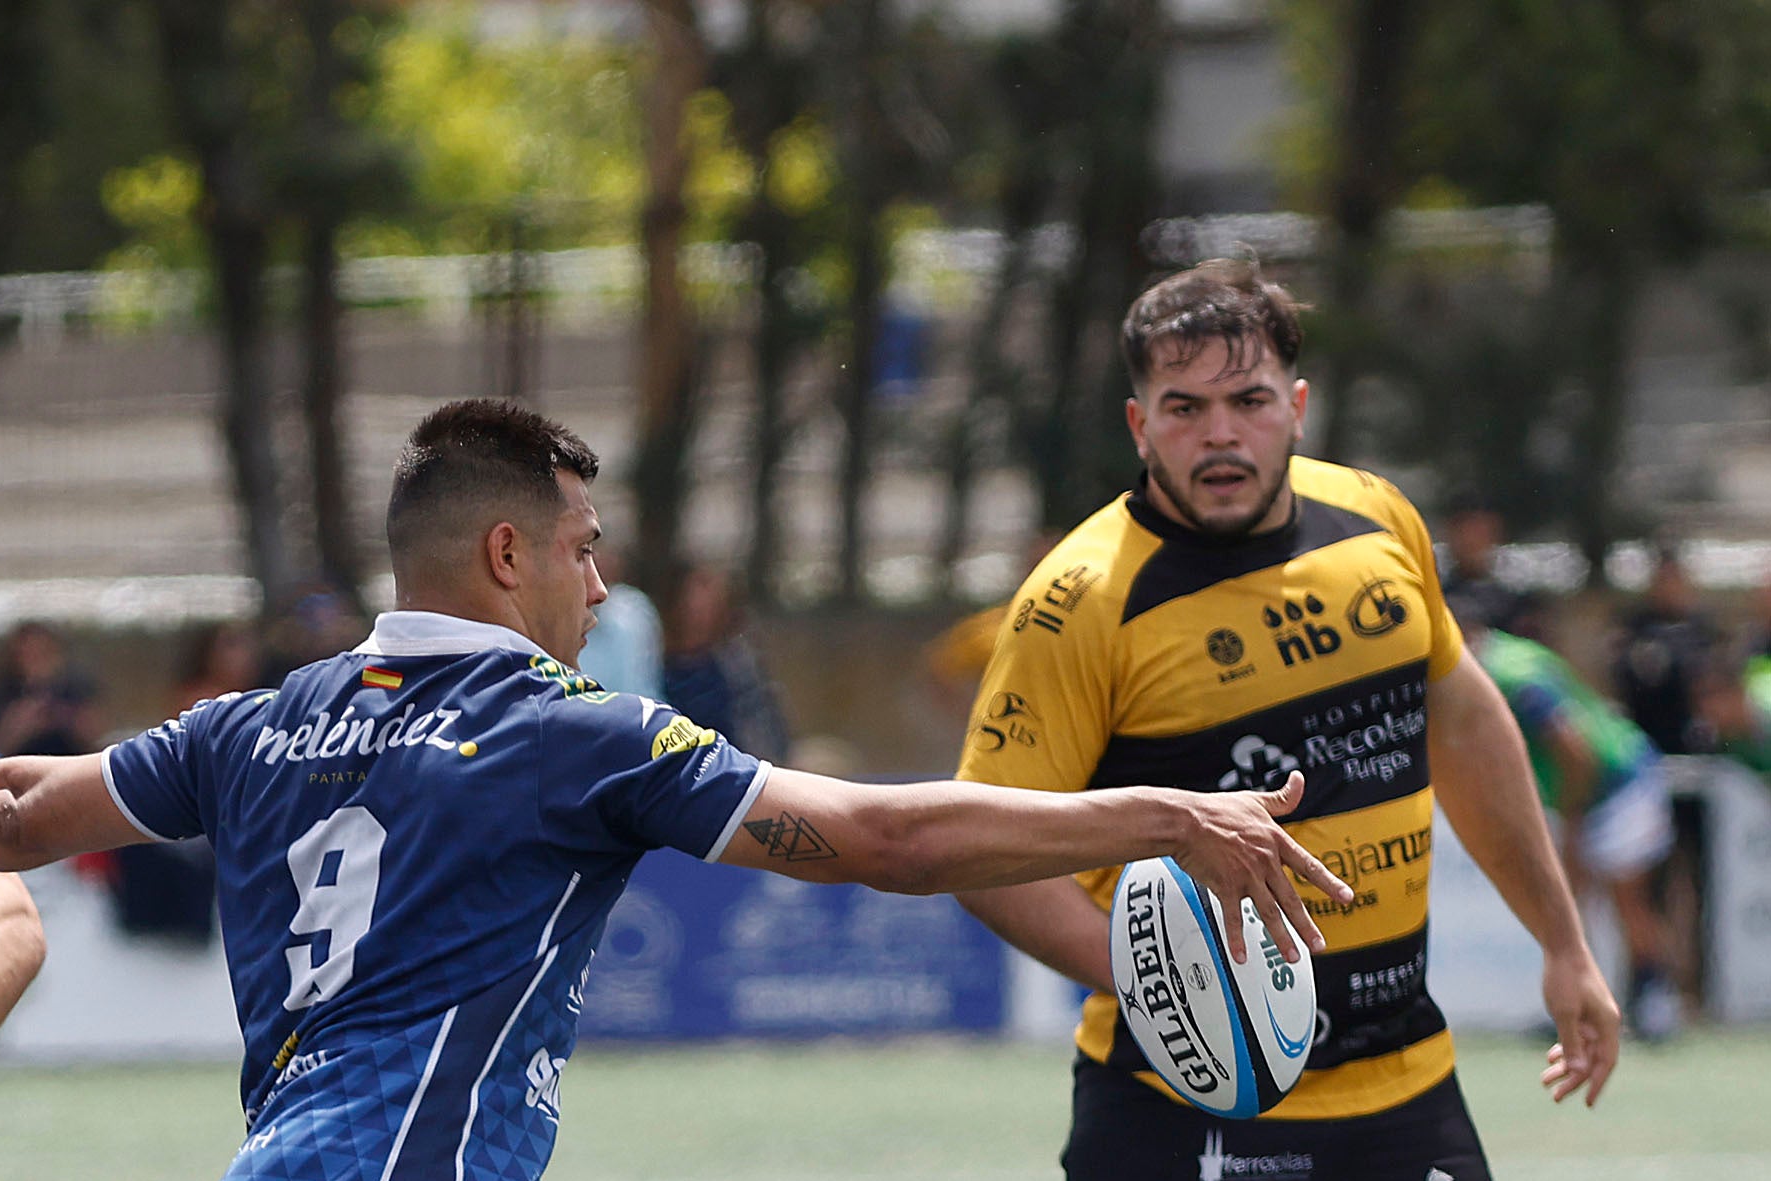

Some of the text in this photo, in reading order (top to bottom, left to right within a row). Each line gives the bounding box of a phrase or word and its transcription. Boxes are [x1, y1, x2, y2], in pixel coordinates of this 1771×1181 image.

[1276, 623, 1342, 667] nb
[285, 807, 387, 1012] 9
[1127, 881, 1219, 1093] GILBERT
